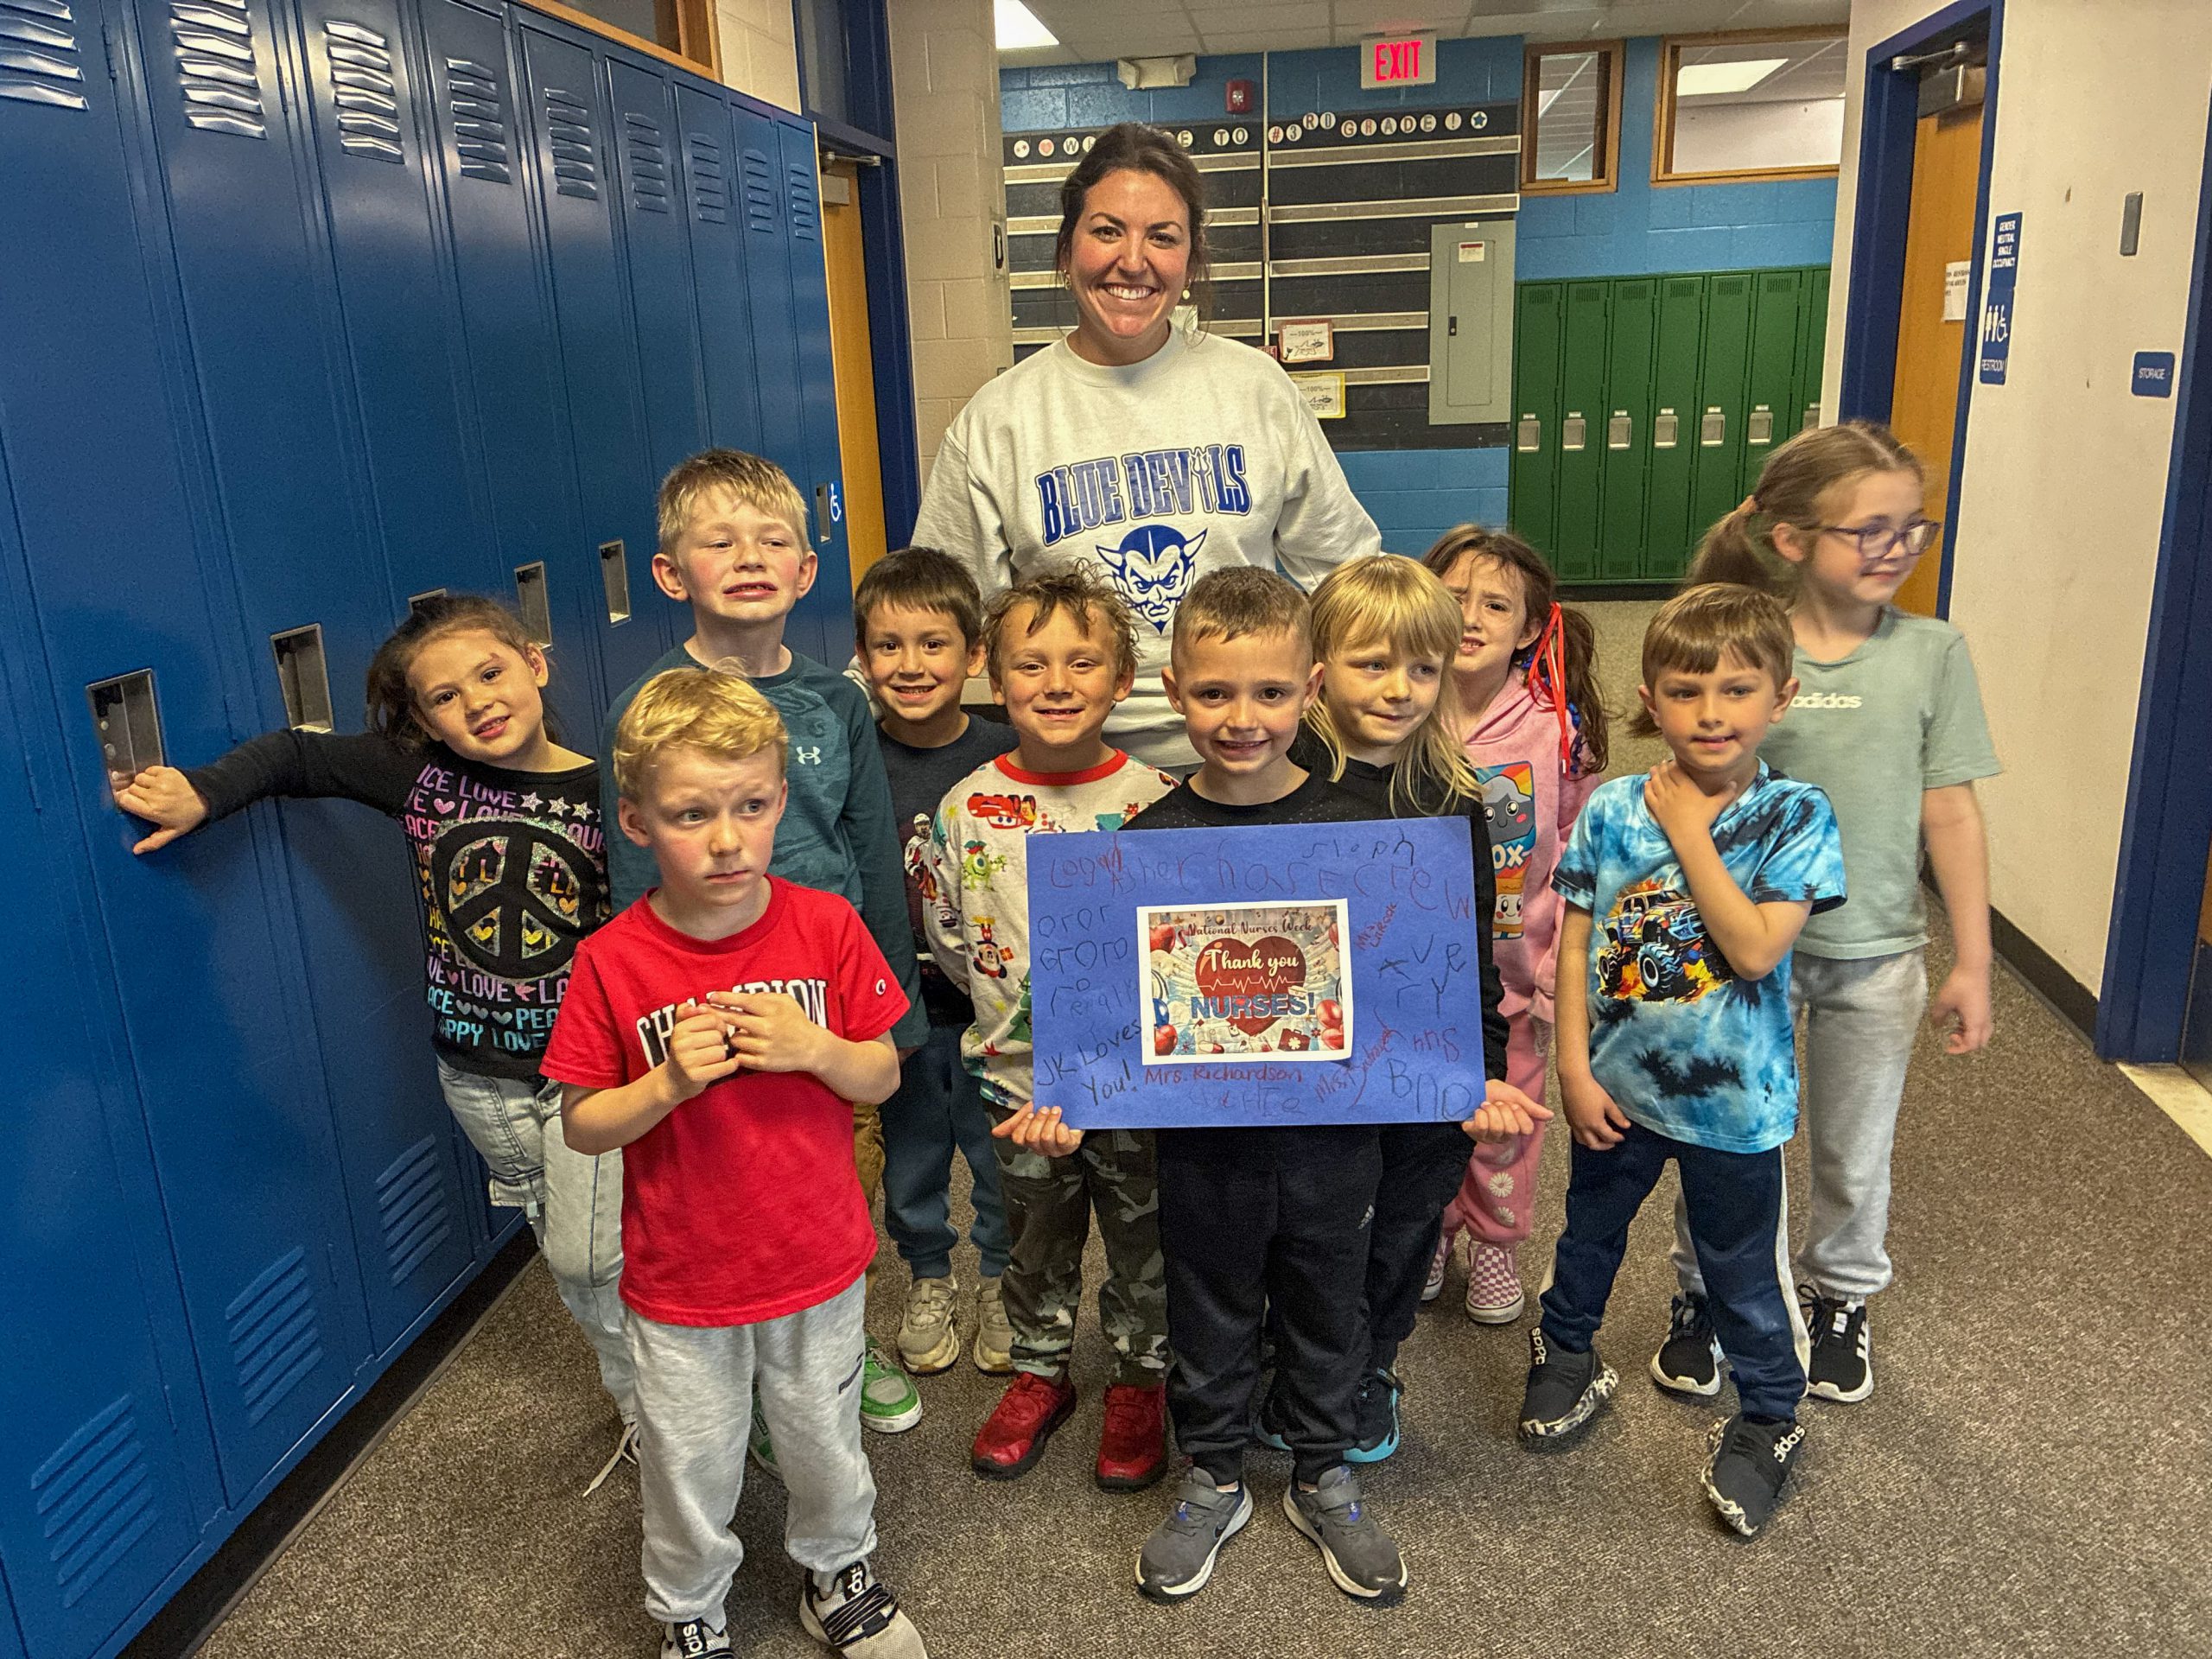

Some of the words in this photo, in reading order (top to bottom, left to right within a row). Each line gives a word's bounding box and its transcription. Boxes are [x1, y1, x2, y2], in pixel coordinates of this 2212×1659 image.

[1374, 40, 1422, 82] EXIT
[1214, 128, 1249, 145] TO
[1981, 359, 2005, 372] RESTROOM
[2138, 367, 2165, 380] STORAGE
[1035, 455, 1126, 547] BLUE
[1121, 443, 1253, 521] DEVILS
[1789, 692, 1863, 709] adidas
[458, 774, 518, 810] LOVE
[1187, 922, 1237, 937] National
[1240, 921, 1278, 935] Nurses
[1282, 918, 1313, 933] Week
[1205, 948, 1264, 972] Thank
[1267, 955, 1300, 977] you
[460, 969, 512, 1002] LOVE
[1190, 992, 1316, 1020] NURSES!
[1037, 1052, 1077, 1086] JK
[1077, 1019, 1141, 1066] Loves
[1080, 1058, 1138, 1106] You!
[1144, 1067, 1188, 1086] Mrs.
[1192, 1064, 1303, 1083] Richardson
